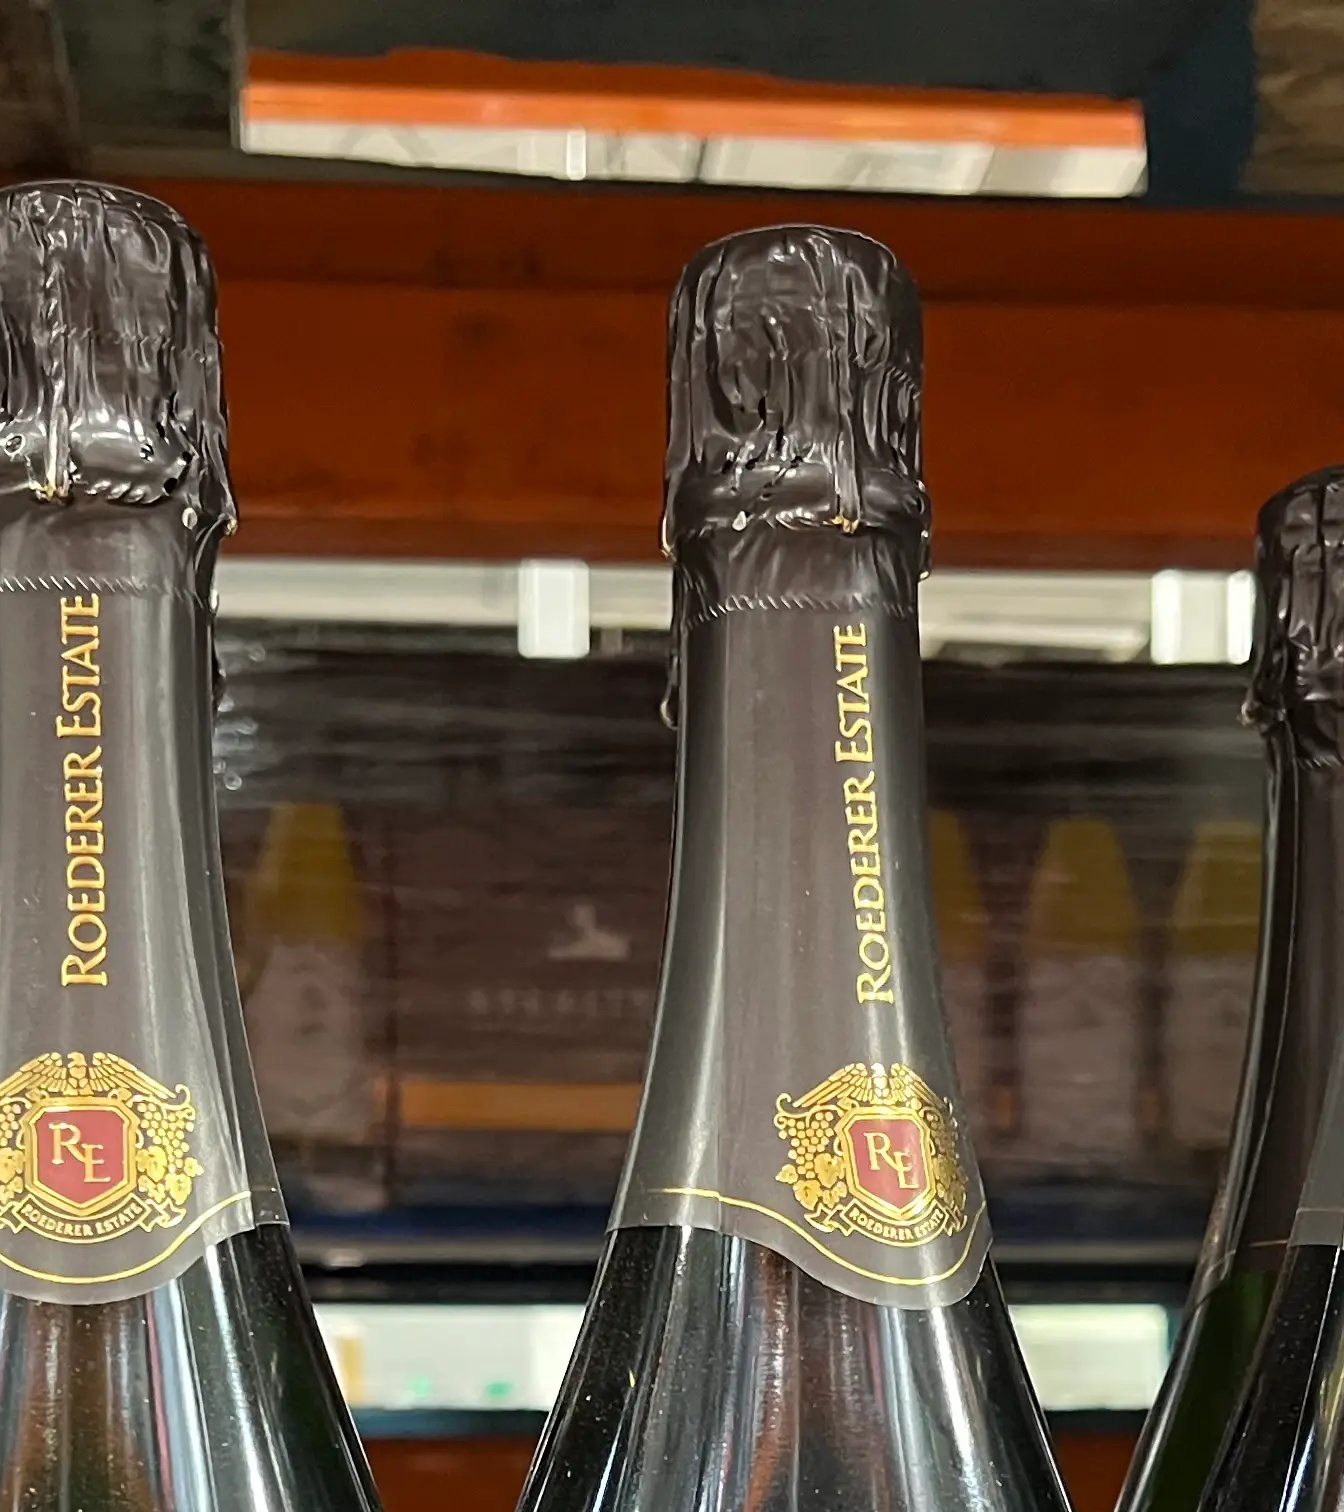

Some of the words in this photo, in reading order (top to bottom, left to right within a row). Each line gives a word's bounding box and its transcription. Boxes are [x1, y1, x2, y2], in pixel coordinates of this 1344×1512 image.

[56, 592, 101, 739] ESTATE
[834, 622, 874, 764] ESTATE
[61, 745, 109, 988] ROEDERER
[844, 770, 895, 1004] ROEDERER
[21, 1204, 93, 1237] ROEDERER
[96, 1204, 144, 1234] ESTATE
